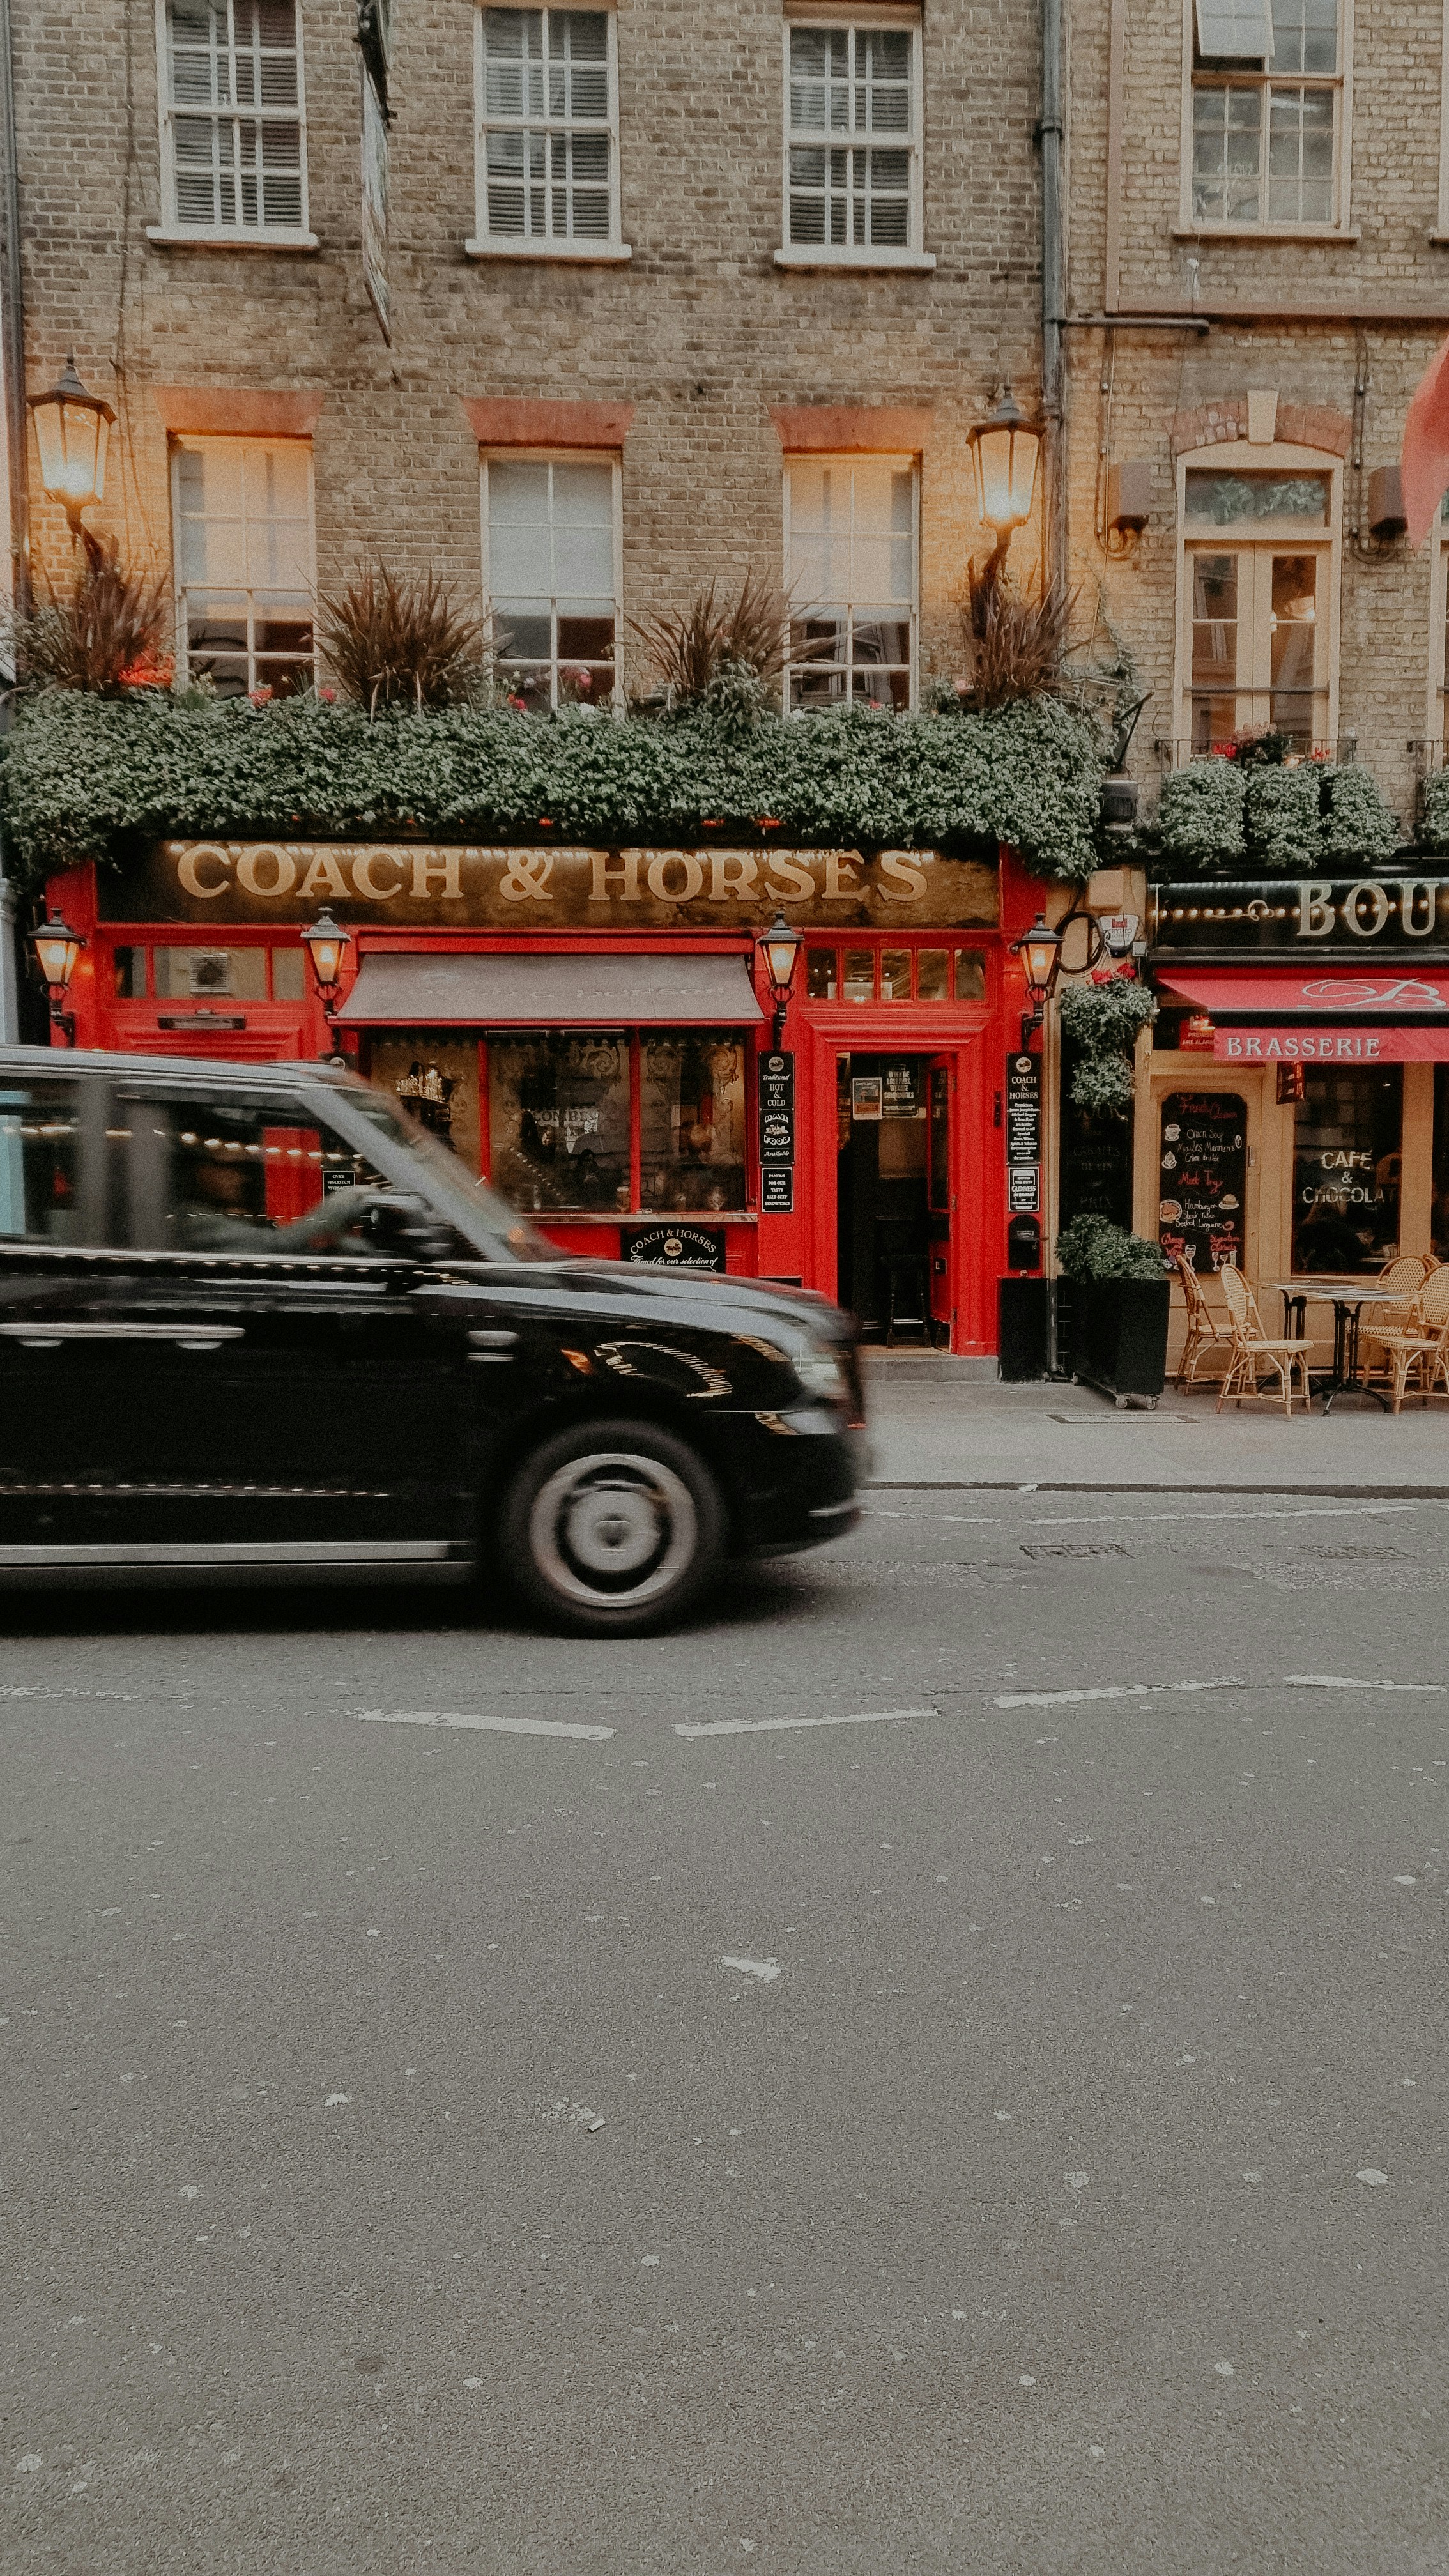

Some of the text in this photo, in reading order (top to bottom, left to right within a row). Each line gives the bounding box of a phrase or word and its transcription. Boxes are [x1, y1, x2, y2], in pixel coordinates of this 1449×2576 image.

[178, 844, 928, 902] COACH & HORSES
[1227, 1037, 1381, 1057] BRASSERIE
[1011, 1076, 1036, 1084] COACH
[1021, 1084, 1029, 1092] &
[774, 1091, 781, 1099] &
[765, 1113, 789, 1123] BAR
[763, 1135, 791, 1146] FOOD
[1321, 1150, 1373, 1170] CAFÉ
[1341, 1170, 1353, 1184] &
[630, 1229, 717, 1254] COACH & HORSES
[655, 1256, 666, 1265] for
[680, 1256, 709, 1265] selection
[709, 1257, 719, 1266] of
